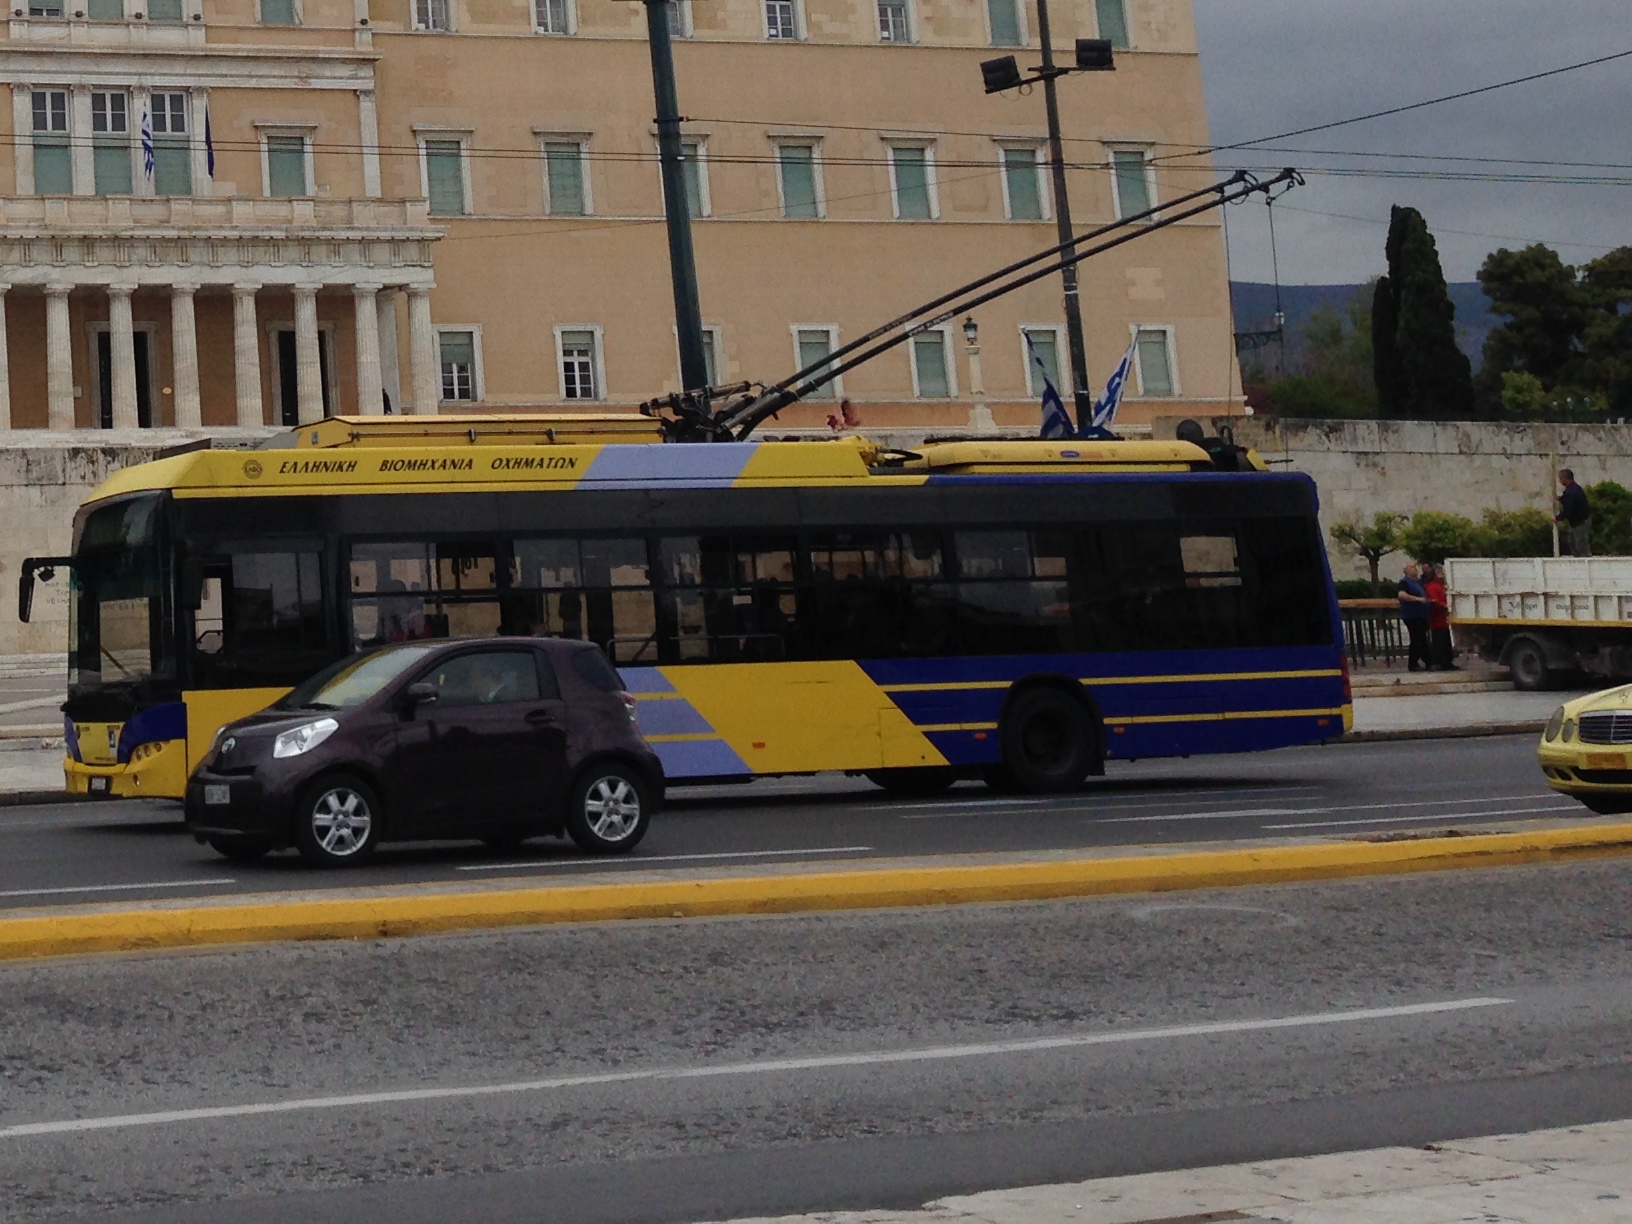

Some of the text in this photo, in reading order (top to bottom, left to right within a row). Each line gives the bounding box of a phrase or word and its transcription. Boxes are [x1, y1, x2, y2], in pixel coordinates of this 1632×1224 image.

[279, 460, 358, 474] ΕΛΛΗΝΙΚΗ
[379, 458, 474, 473] ΒΙΟΜΗΧΑΝΙΑ
[490, 456, 578, 471] ΟΧΗΜΑΤΩΝ
